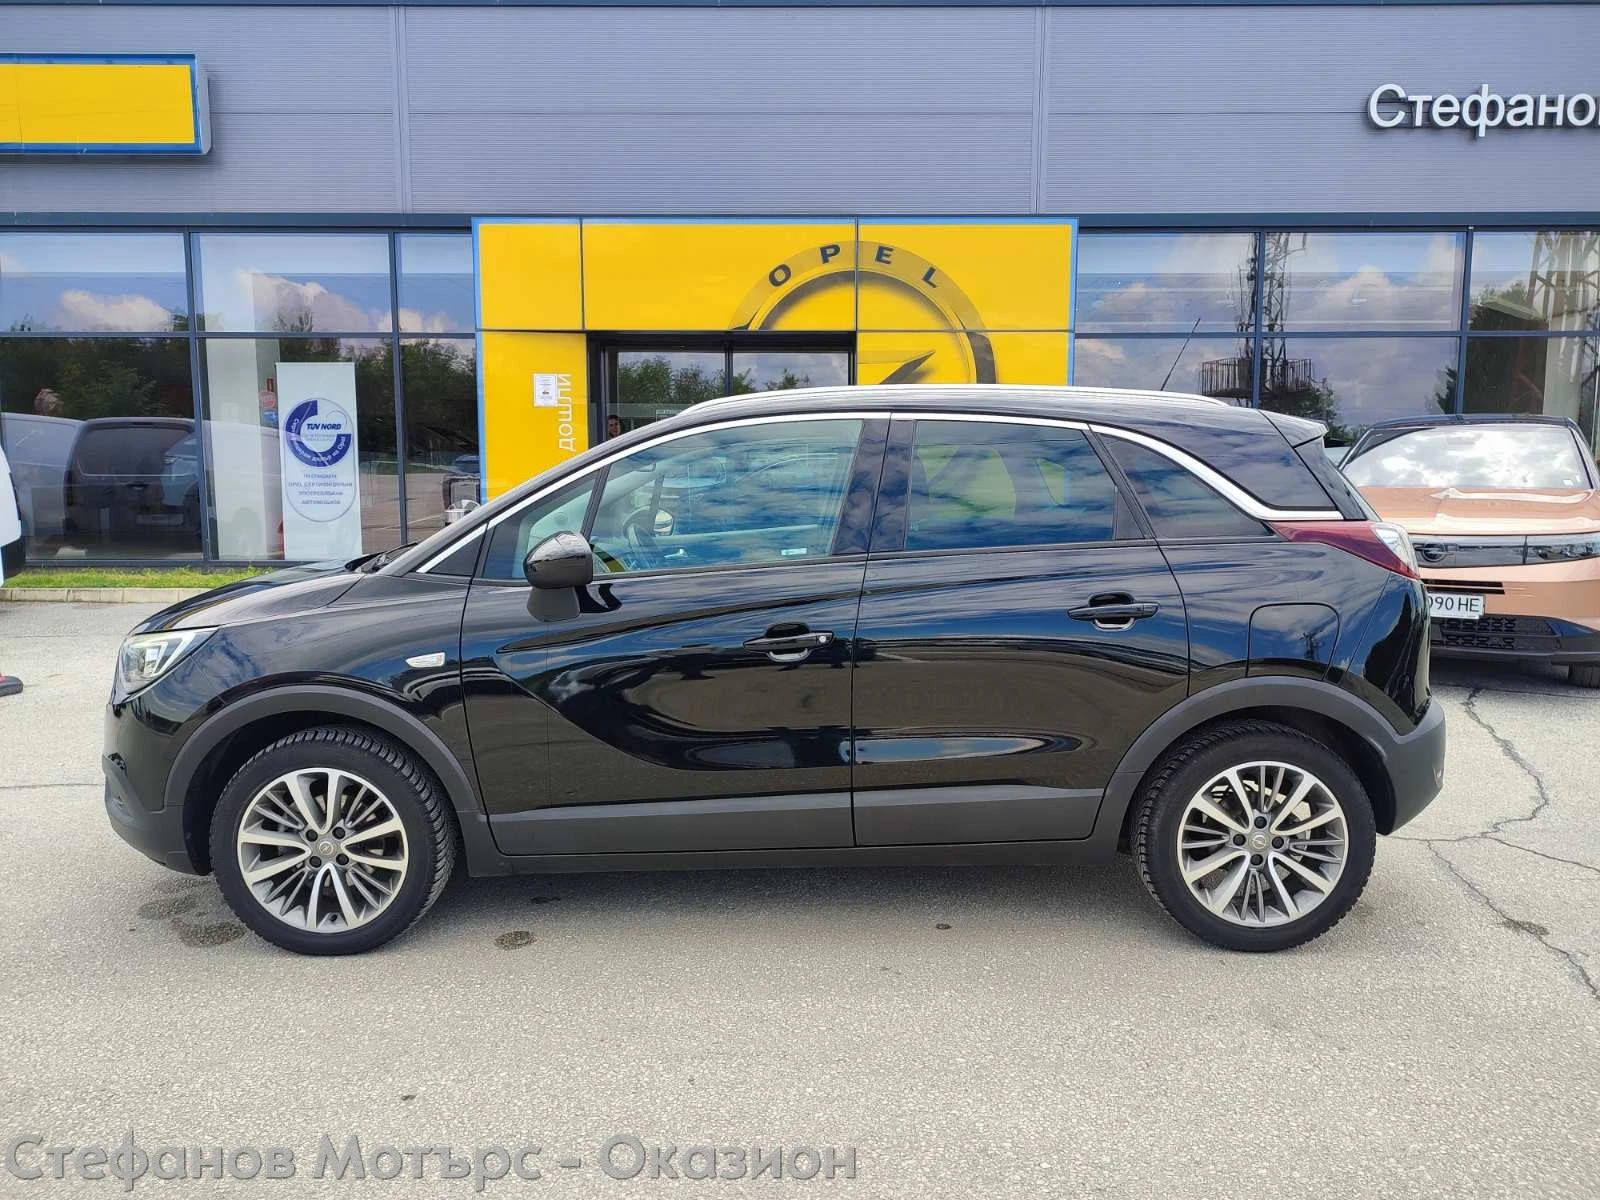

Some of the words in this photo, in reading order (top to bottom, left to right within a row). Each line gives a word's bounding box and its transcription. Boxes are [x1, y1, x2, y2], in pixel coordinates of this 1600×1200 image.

[1369, 83, 1600, 138] Стефано
[768, 244, 937, 289] OPEL
[558, 373, 577, 453] ДОШЛИ
[1458, 597, 1480, 612] HE
